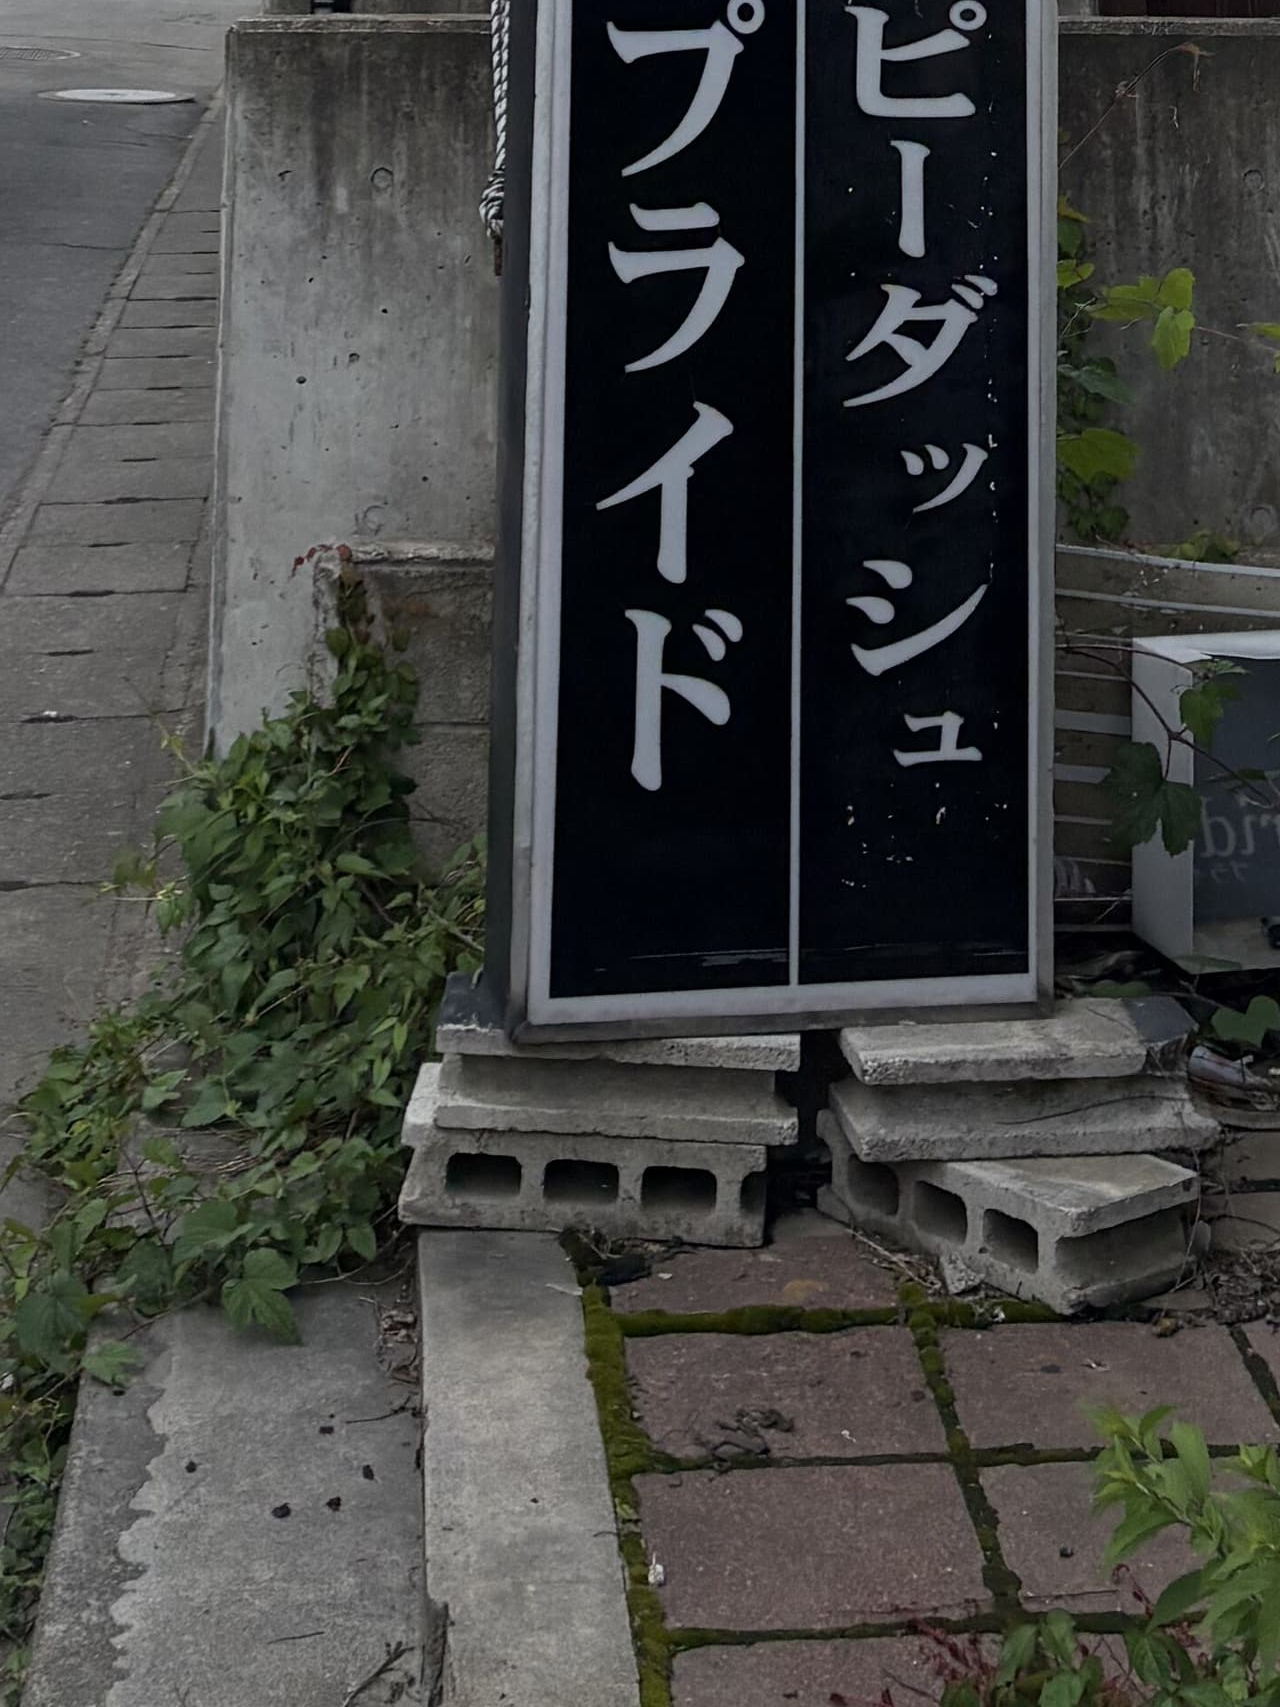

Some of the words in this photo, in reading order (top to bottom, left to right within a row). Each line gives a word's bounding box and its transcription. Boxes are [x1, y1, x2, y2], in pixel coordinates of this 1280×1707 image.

[842, 0, 999, 767] ピーダッシュ
